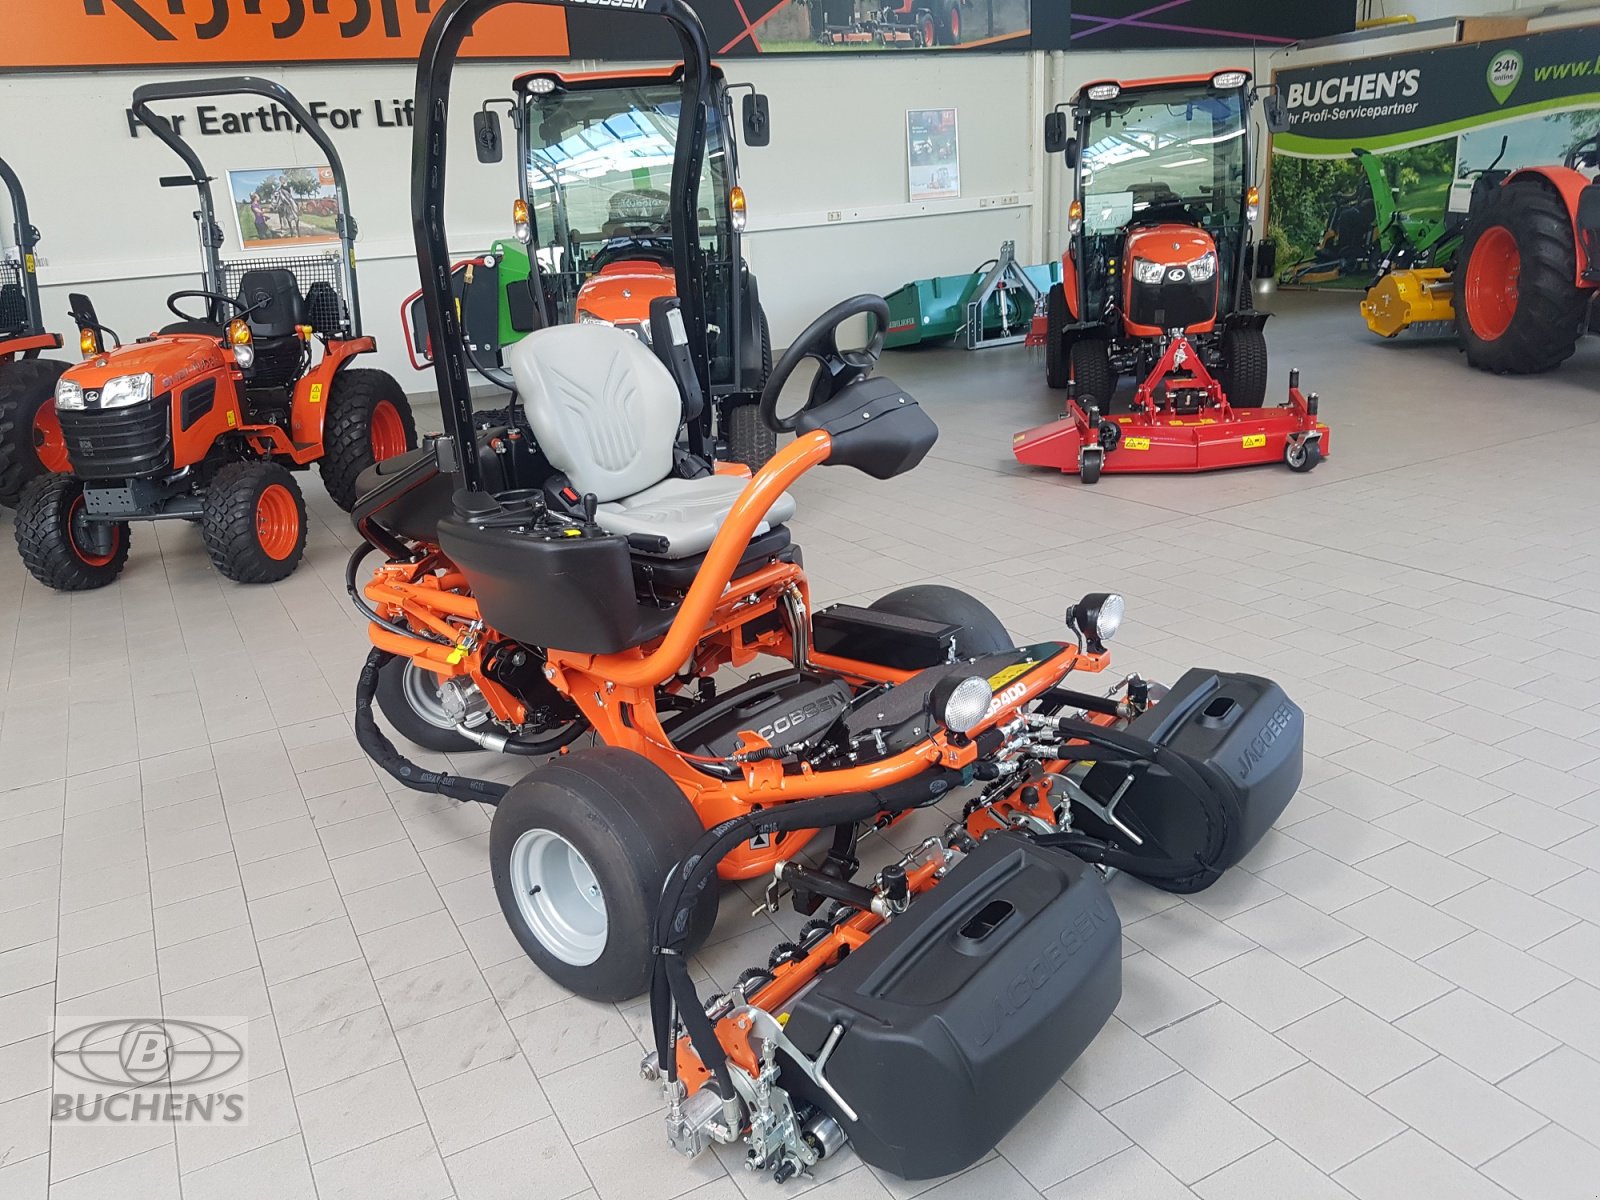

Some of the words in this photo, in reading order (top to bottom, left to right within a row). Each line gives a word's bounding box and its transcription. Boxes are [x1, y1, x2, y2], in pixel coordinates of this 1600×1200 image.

[1494, 59, 1518, 72] 24h
[1287, 69, 1420, 109] BUCHEN'S
[308, 101, 362, 129] For
[1301, 102, 1419, 124] Profi-Servicepartner
